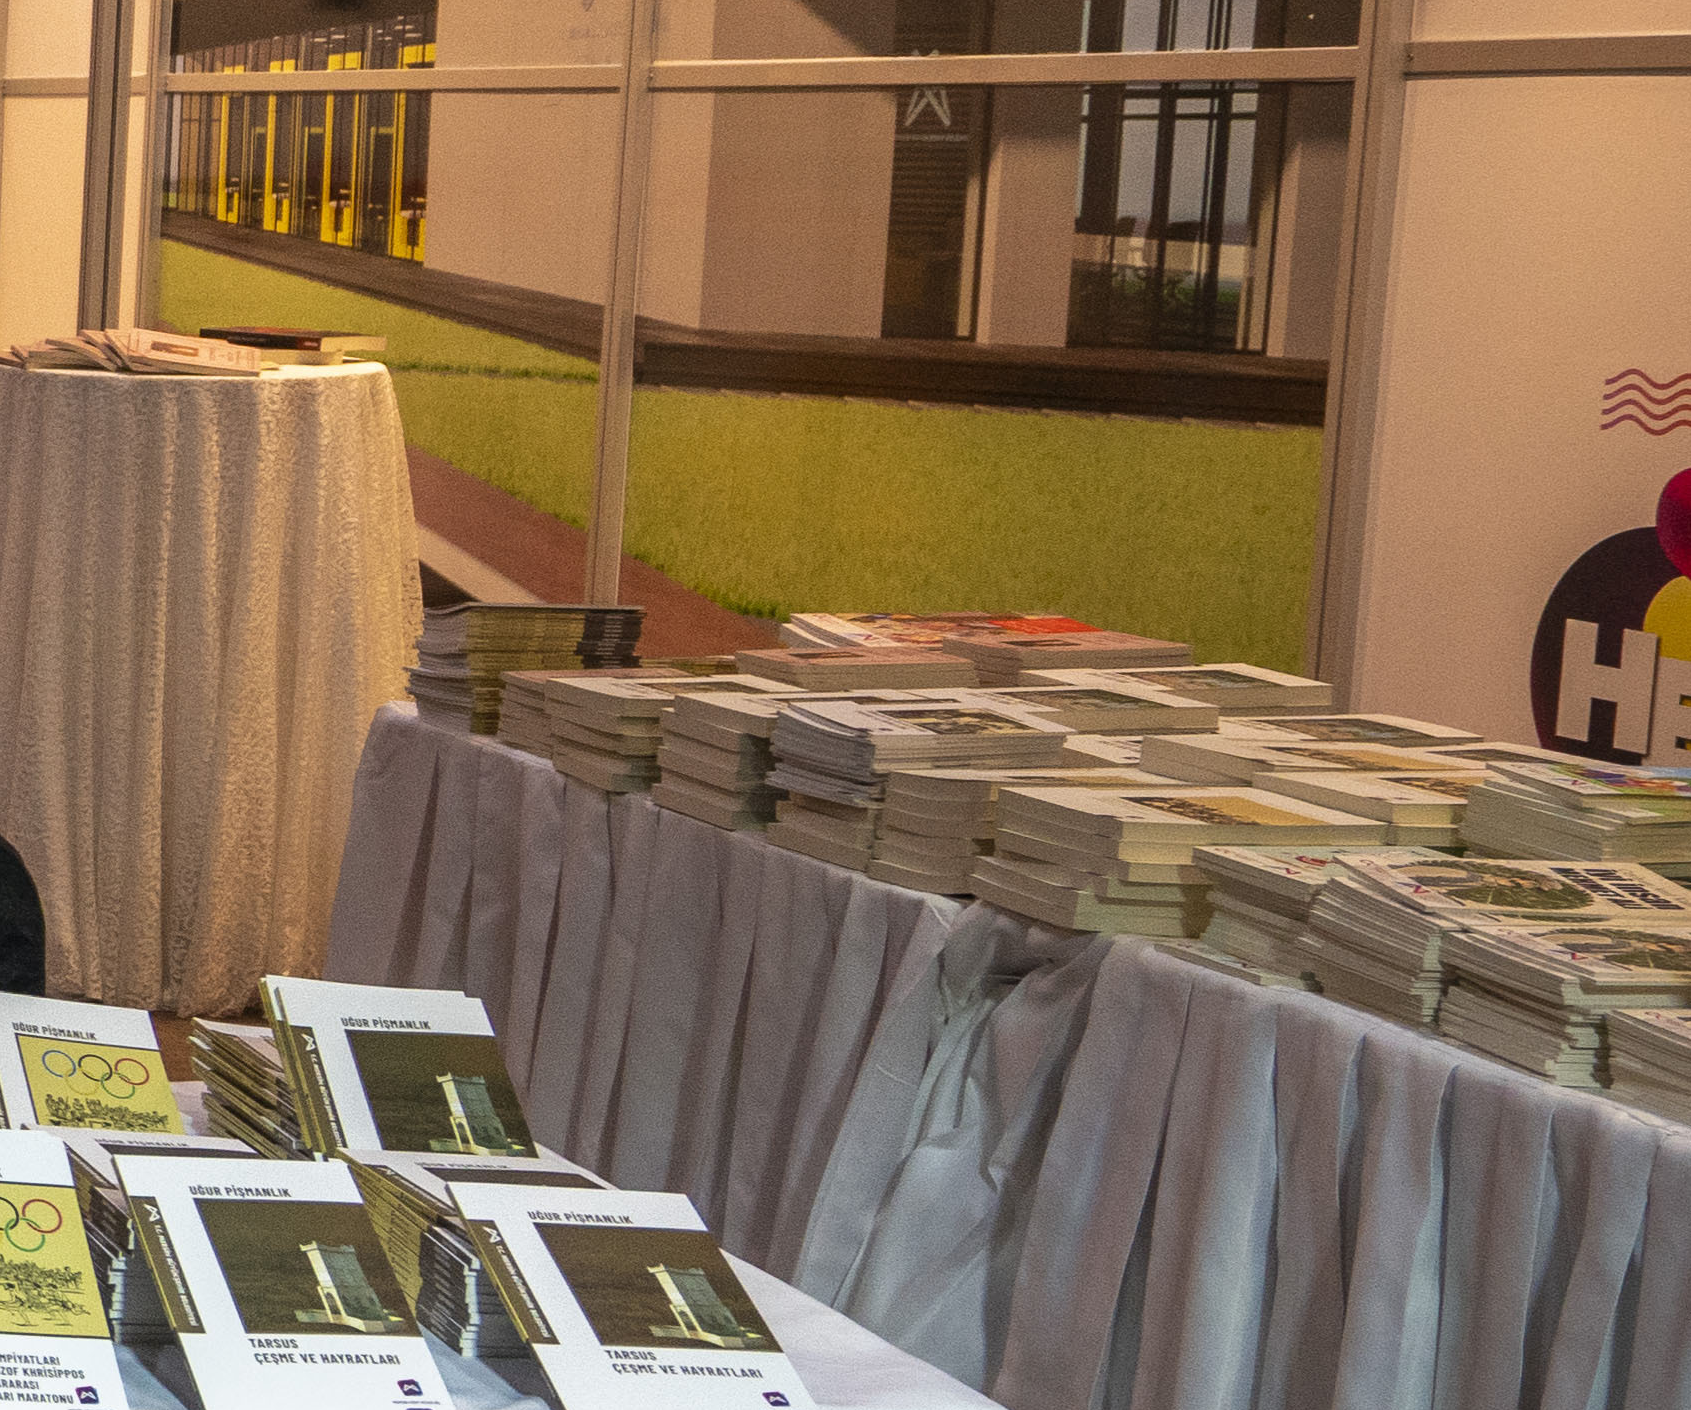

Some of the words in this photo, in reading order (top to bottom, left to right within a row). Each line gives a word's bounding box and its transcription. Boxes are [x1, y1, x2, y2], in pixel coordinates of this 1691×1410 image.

[340, 1017, 369, 1028] UĞUR
[372, 1017, 431, 1030] PİŞMANLIK
[12, 1022, 39, 1035] UĞUR
[42, 1024, 97, 1040] PİŞMANLIK
[189, 1185, 221, 1196] UĞUR
[224, 1185, 291, 1198] PİŞMANLIK
[527, 1211, 562, 1222] UĞUR
[565, 1211, 633, 1225] PİŞMANLIK
[248, 1338, 298, 1349] TARSUS
[255, 1353, 296, 1365] ÇEŞME
[300, 1354, 318, 1363] VE
[321, 1354, 401, 1365] HAYRATLARI
[605, 1350, 657, 1361] TARSUS
[23, 1367, 85, 1380] KHRİSİPPOS
[612, 1363, 656, 1376] ÇEŞME
[660, 1365, 679, 1375] VE
[680, 1366, 763, 1379] HAYRATLARI
[17, 1392, 74, 1404] MARATONU
